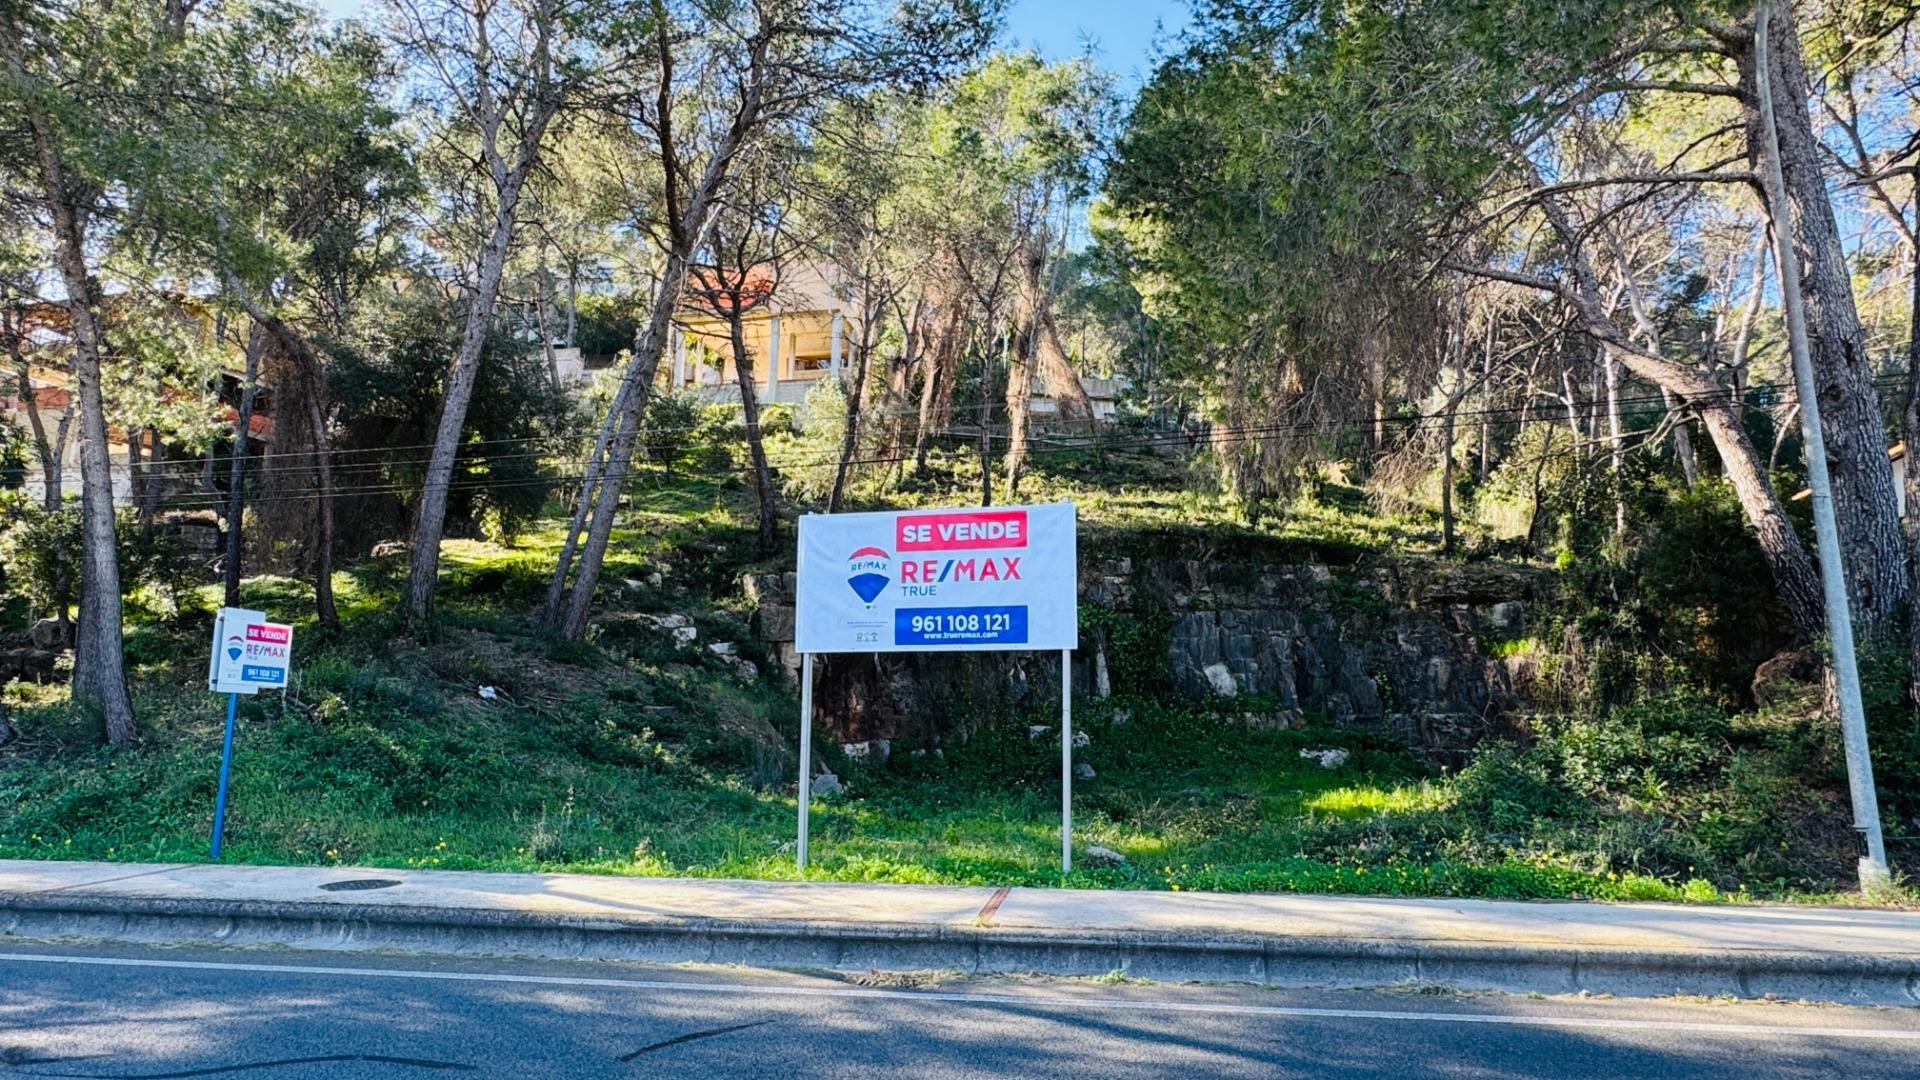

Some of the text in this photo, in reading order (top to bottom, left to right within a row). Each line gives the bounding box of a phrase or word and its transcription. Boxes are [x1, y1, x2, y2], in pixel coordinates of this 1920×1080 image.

[902, 520, 1020, 543] SE VENDE
[850, 560, 888, 572] RE/MAX
[901, 557, 1022, 584] RE/MAX
[901, 585, 937, 597] TRUE
[911, 613, 1010, 632] 961 108 121
[248, 628, 288, 641] SE VENDE
[923, 631, 998, 639] www.trueremax.com
[246, 644, 286, 658] RE/MAX
